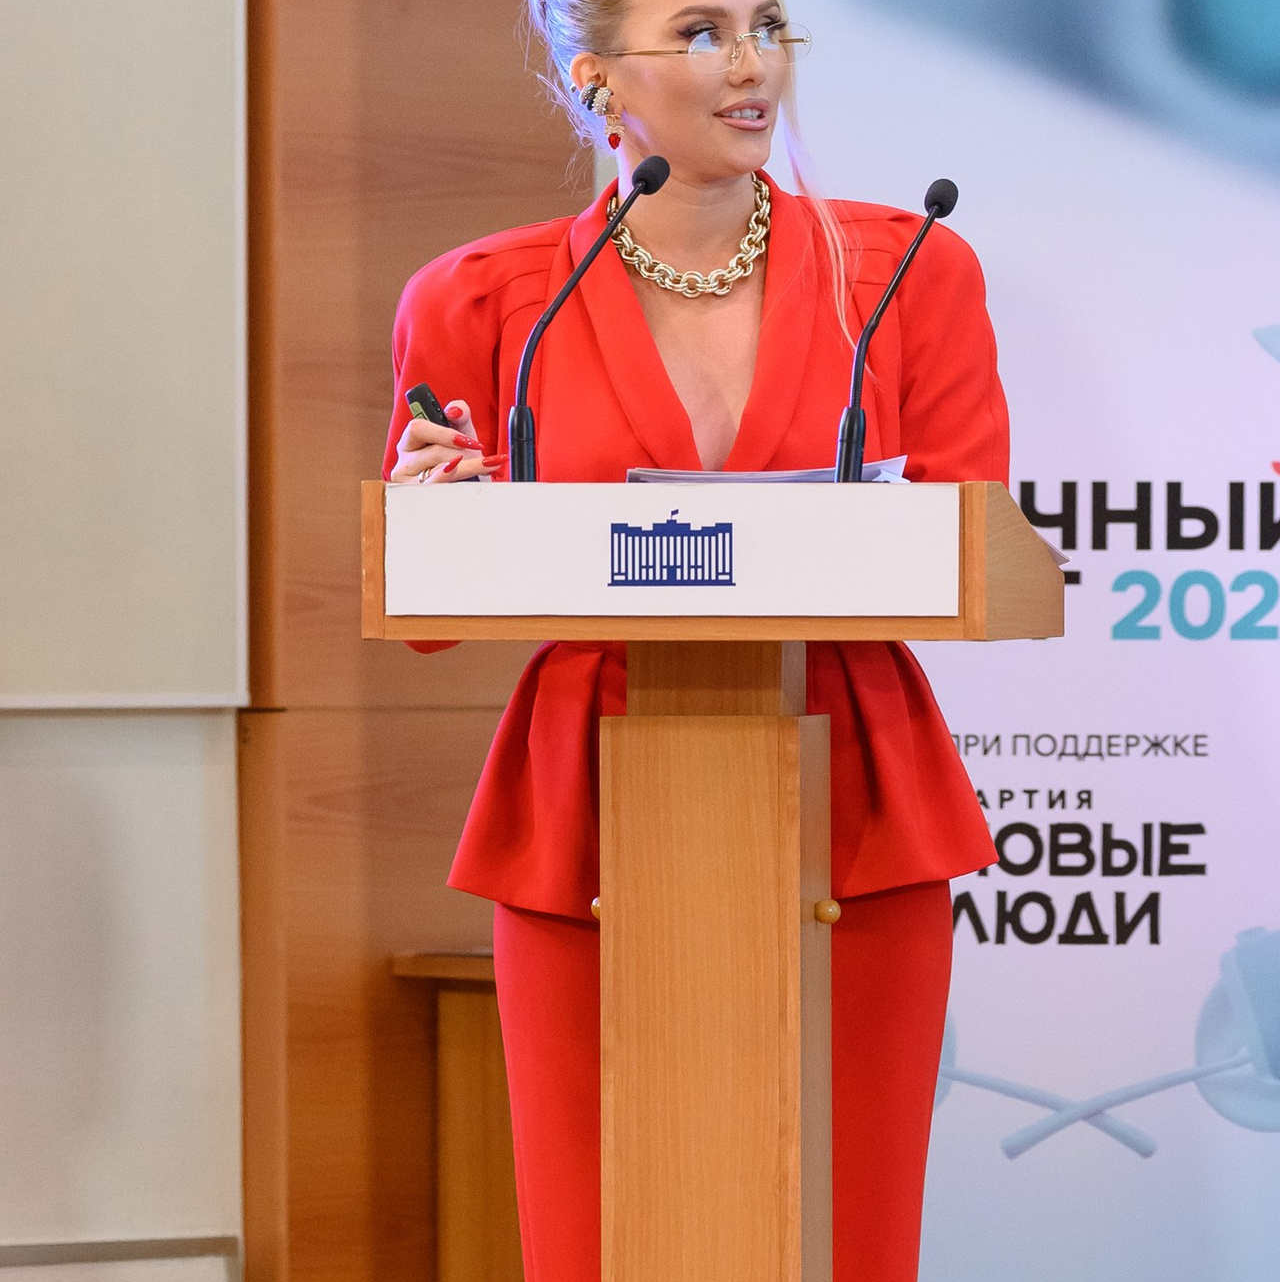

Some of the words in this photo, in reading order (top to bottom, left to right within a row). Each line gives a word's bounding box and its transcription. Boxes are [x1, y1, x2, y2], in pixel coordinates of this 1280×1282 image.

[1012, 734, 1209, 761] ПОДДЕРЖКЕ
[978, 822, 1207, 877] ОВЫЕ
[953, 891, 1160, 945] ЛЮДИ
